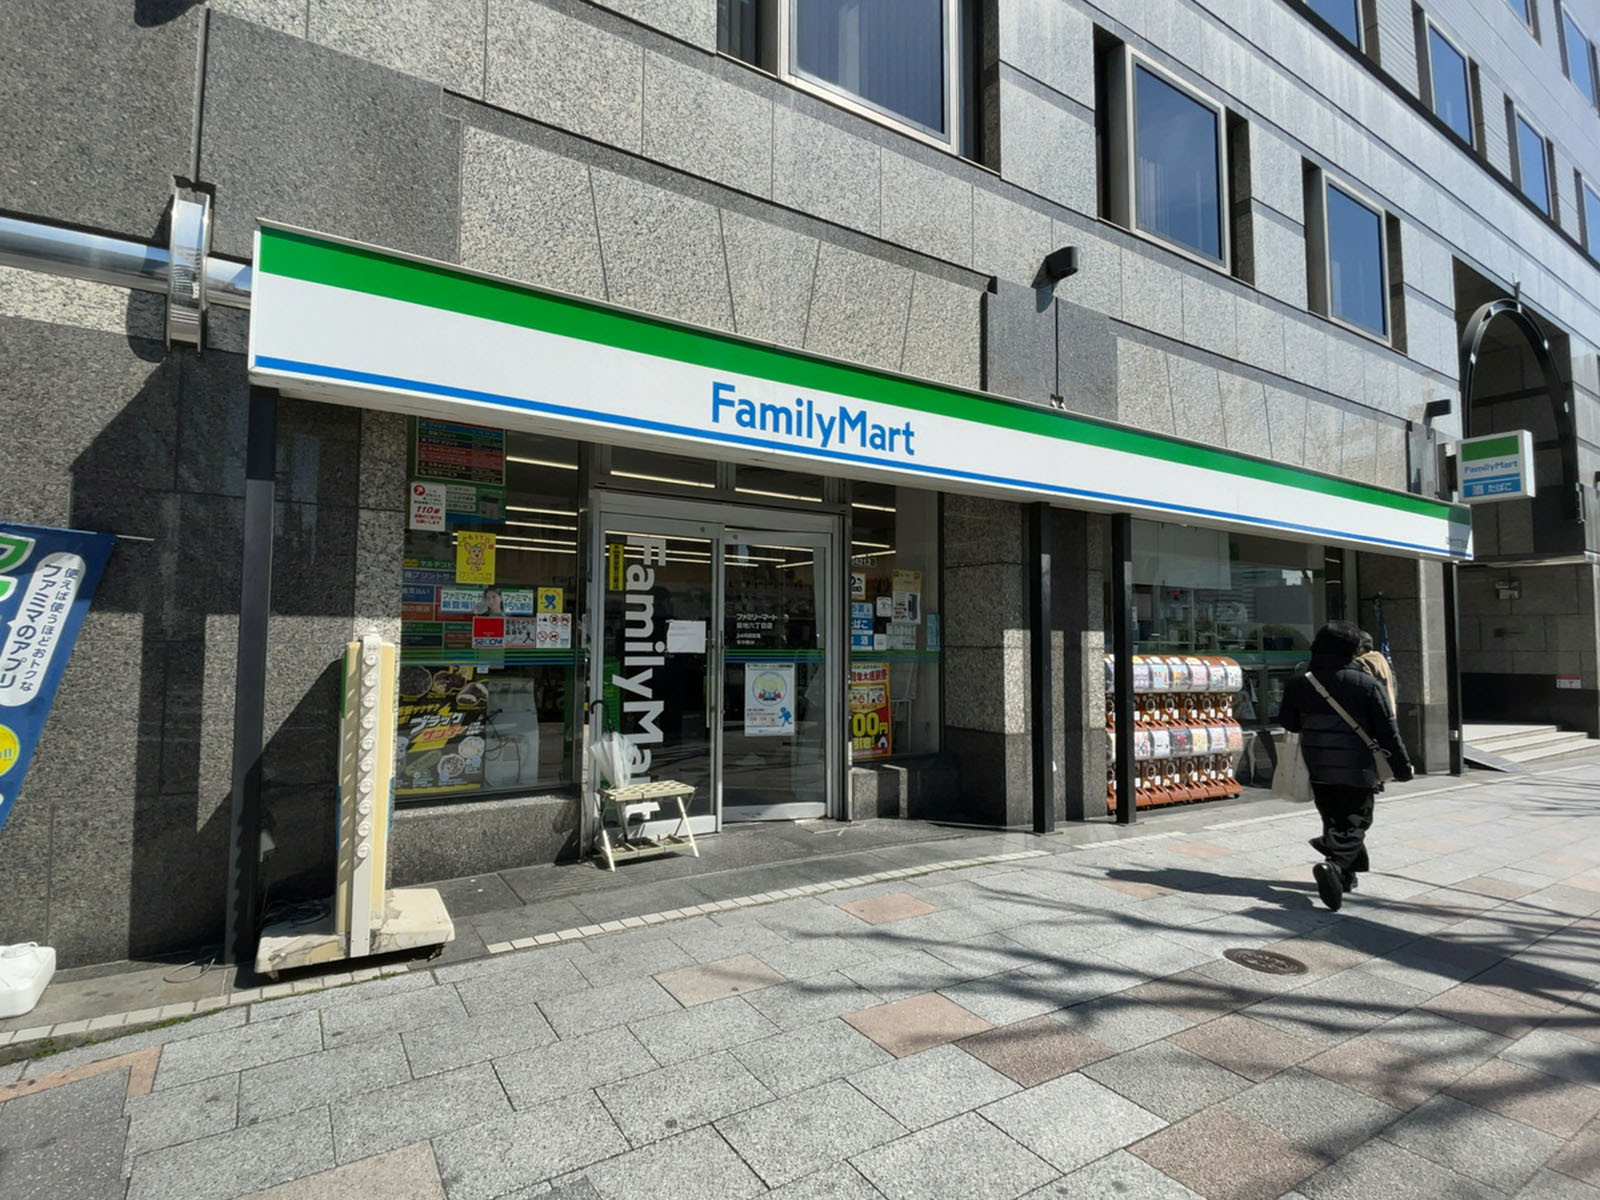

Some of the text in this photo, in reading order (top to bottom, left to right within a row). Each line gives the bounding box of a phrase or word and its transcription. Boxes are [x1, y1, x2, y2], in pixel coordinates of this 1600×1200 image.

[712, 381, 915, 456] FamilyMart
[1464, 460, 1519, 474] FamilyMart
[0, 563, 62, 690] ファミマのアプリ
[19, 567, 80, 693] 使えば使うほどおトクな
[736, 613, 778, 622] ファミリーマート
[474, 637, 505, 647] SECOM
[612, 536, 666, 821] FamilyMat
[409, 711, 464, 736] ブラック
[423, 726, 467, 740] サンダー
